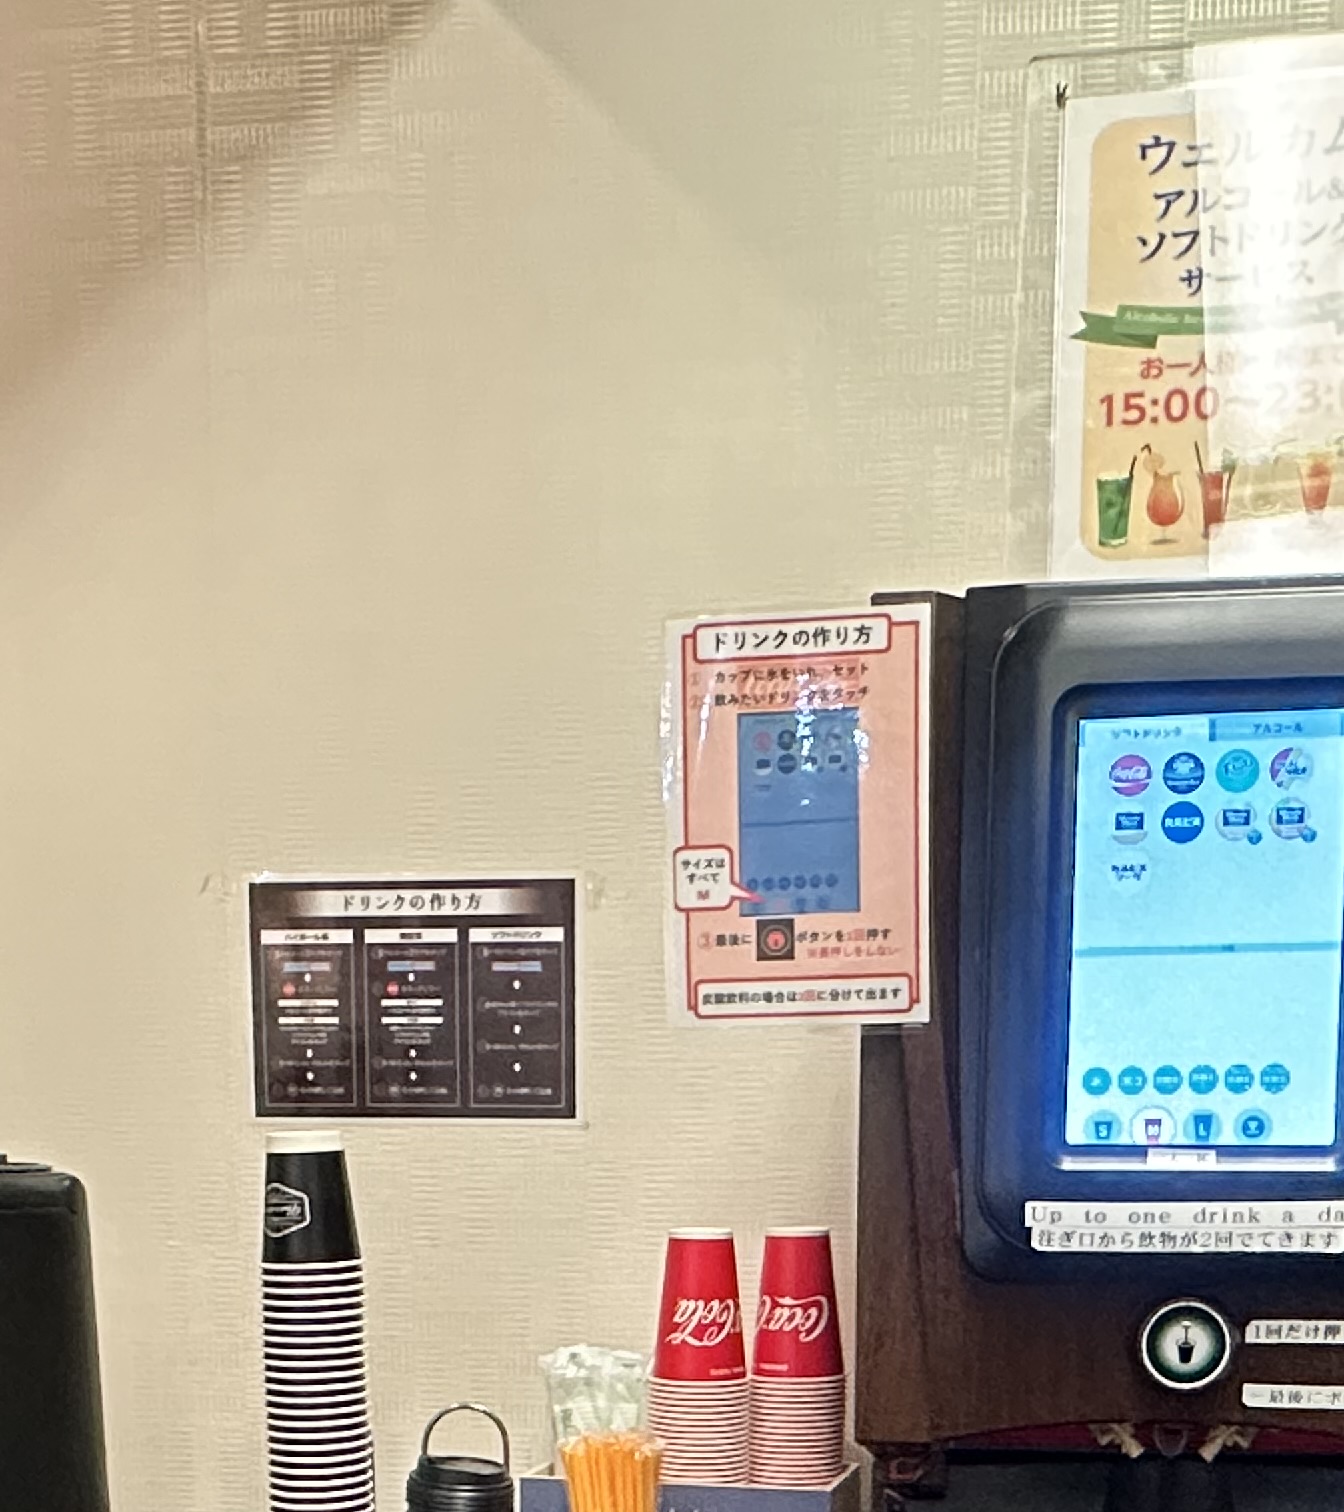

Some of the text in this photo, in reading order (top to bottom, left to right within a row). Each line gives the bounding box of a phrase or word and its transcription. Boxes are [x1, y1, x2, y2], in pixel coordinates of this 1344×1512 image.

[714, 624, 873, 653] ドリンクの作り方
[715, 686, 869, 706] 飲みたいドリクをタッチ
[681, 857, 725, 870] サイズは
[686, 872, 720, 884] すべて
[343, 893, 483, 911] ドリンクの作り方
[1098, 1124, 1108, 1137] S
[1148, 1124, 1159, 1136] M
[1198, 1123, 1207, 1136] L
[1030, 1206, 1062, 1225] Up
[1084, 1208, 1107, 1224] to
[1127, 1210, 1171, 1224] one
[1193, 1207, 1261, 1224] drink
[1282, 1211, 1295, 1223] a
